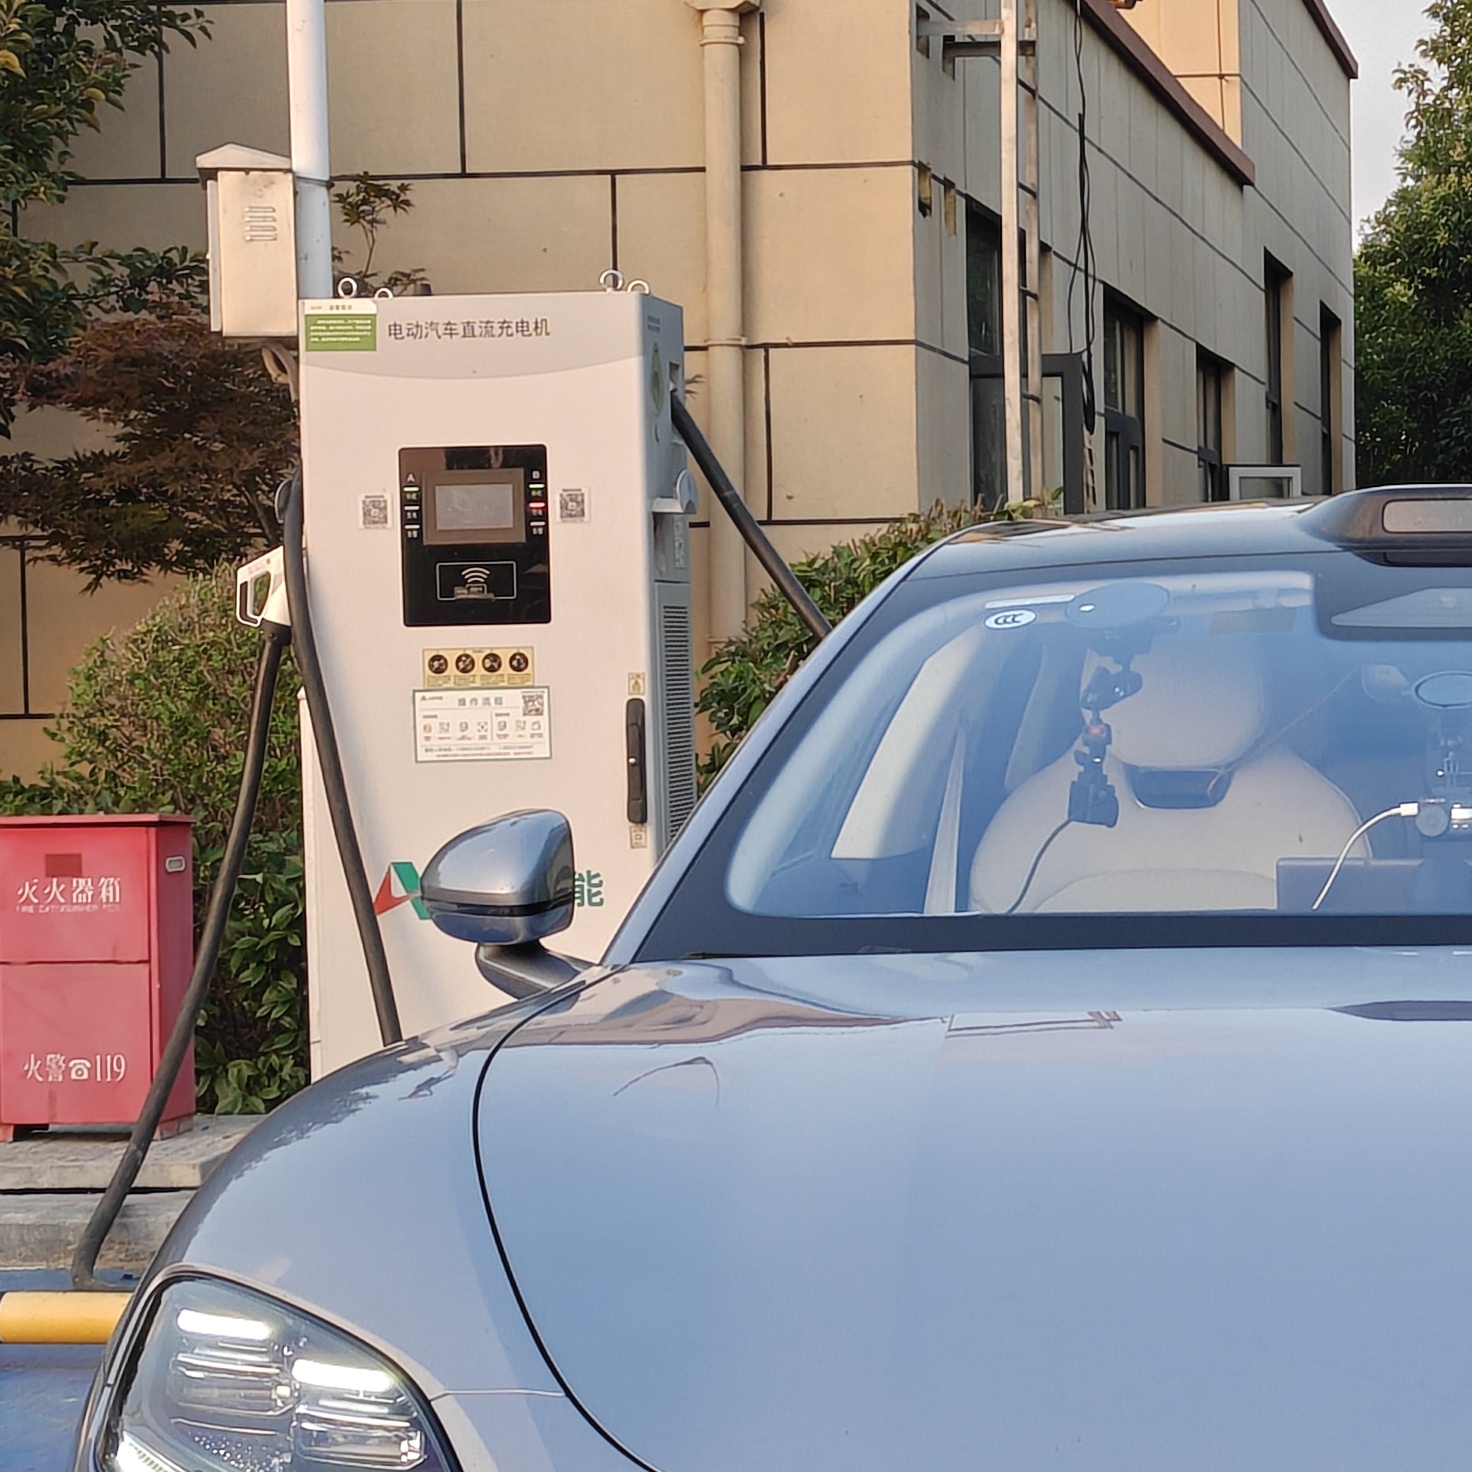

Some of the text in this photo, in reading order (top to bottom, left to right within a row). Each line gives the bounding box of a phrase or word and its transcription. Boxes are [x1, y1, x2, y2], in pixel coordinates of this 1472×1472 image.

[387, 317, 550, 340] 电动汽车直流充电机
[23, 1052, 127, 1083] 火警 119
